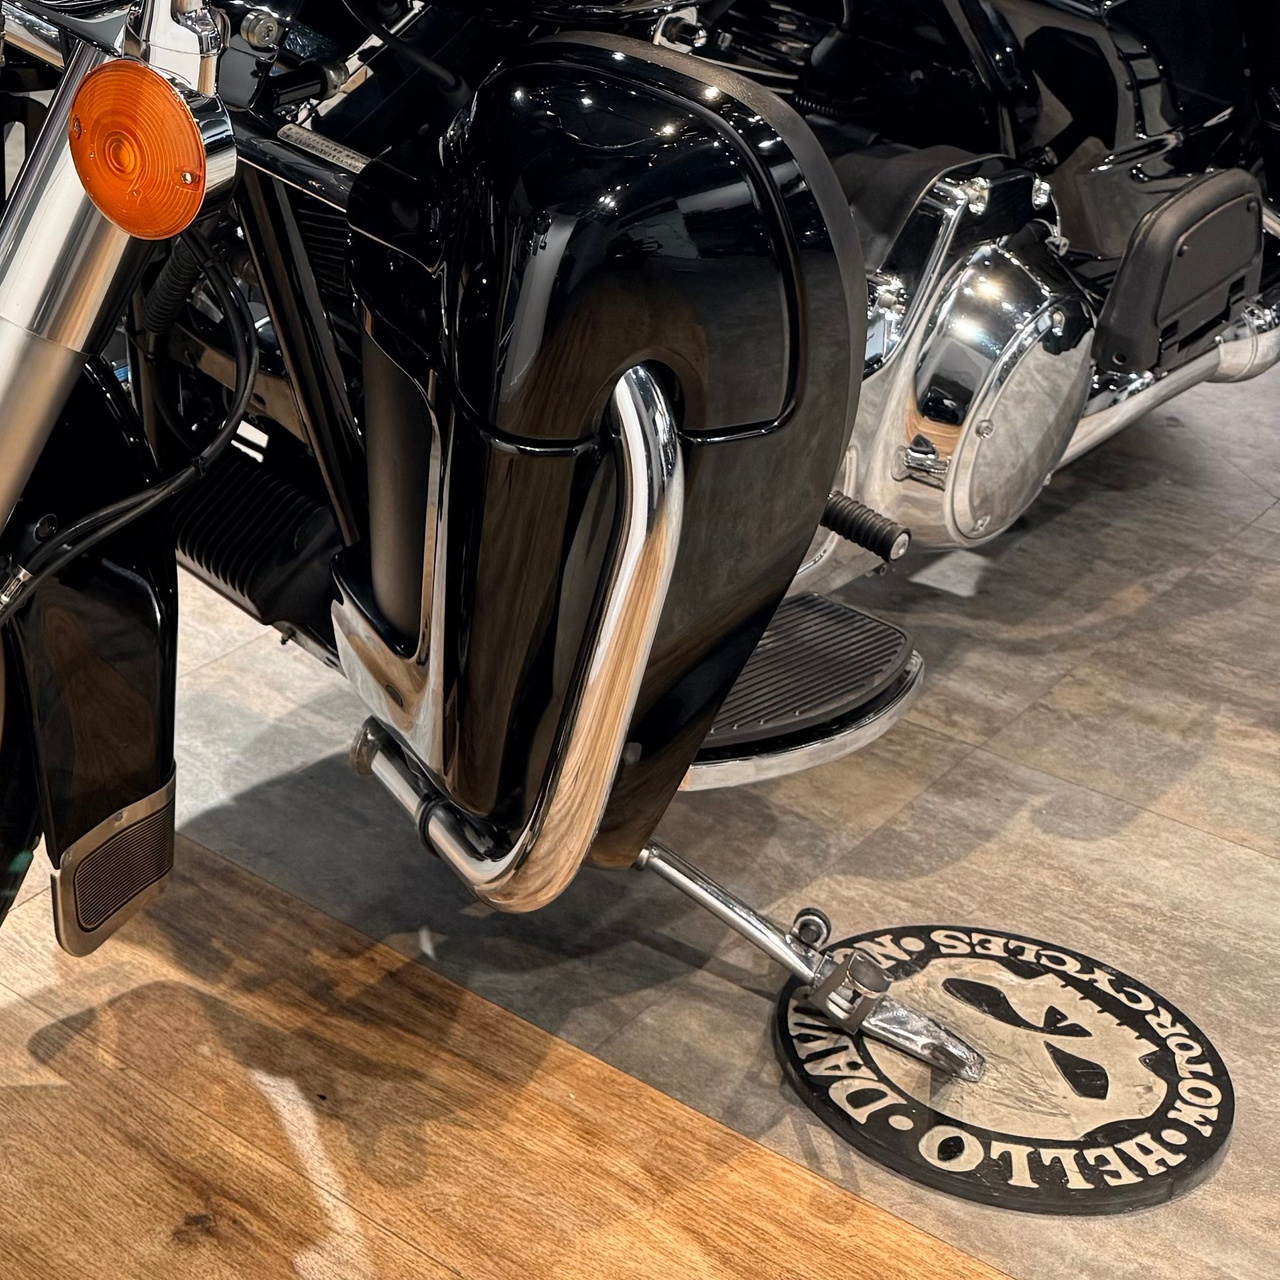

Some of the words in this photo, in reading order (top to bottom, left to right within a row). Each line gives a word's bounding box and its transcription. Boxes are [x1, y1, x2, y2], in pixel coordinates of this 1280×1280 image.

[787, 935, 908, 1125] DAVIN
[930, 930, 1223, 1138] MOTORCYCLES
[918, 1125, 1188, 1191] HELLO
